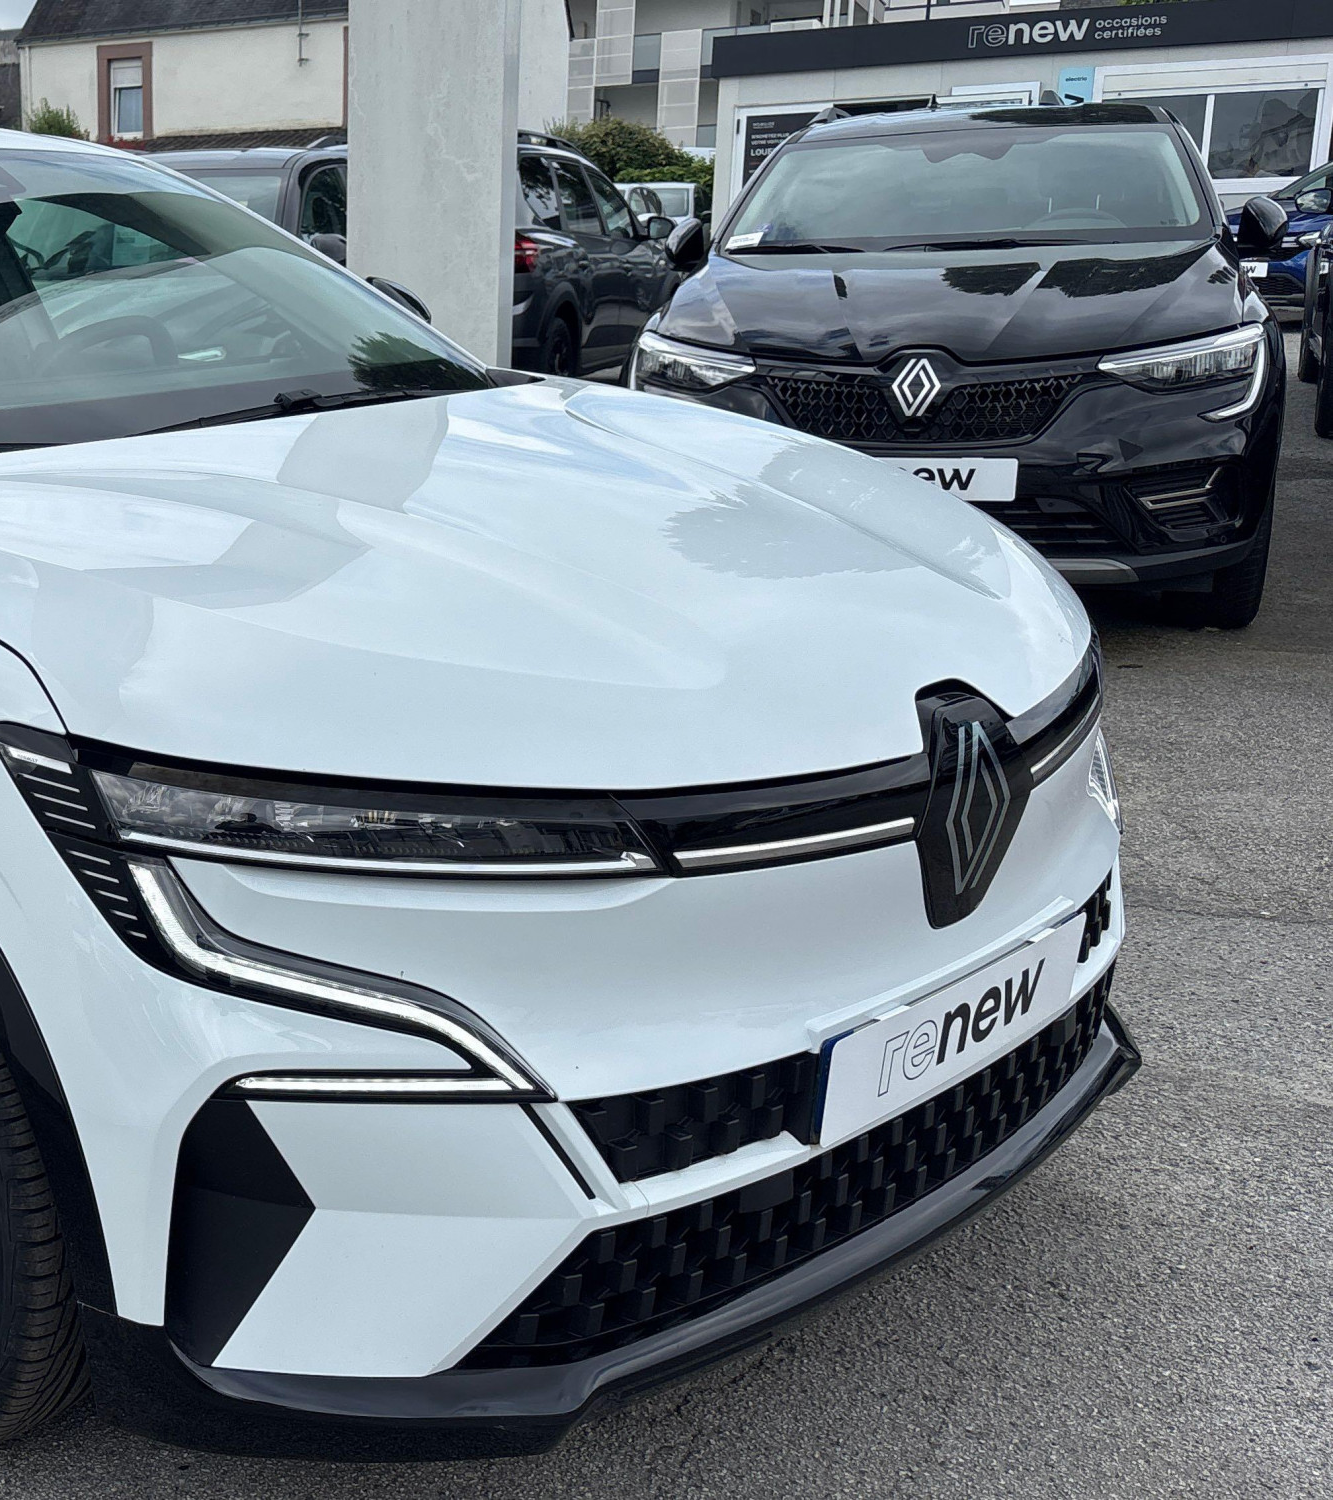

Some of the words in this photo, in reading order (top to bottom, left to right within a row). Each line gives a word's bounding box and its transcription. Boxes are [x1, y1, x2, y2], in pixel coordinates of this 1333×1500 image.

[1095, 15, 1167, 28] occasions
[967, 18, 1091, 49] renew
[1094, 26, 1162, 40] certifiées
[877, 957, 1046, 1098] renew
